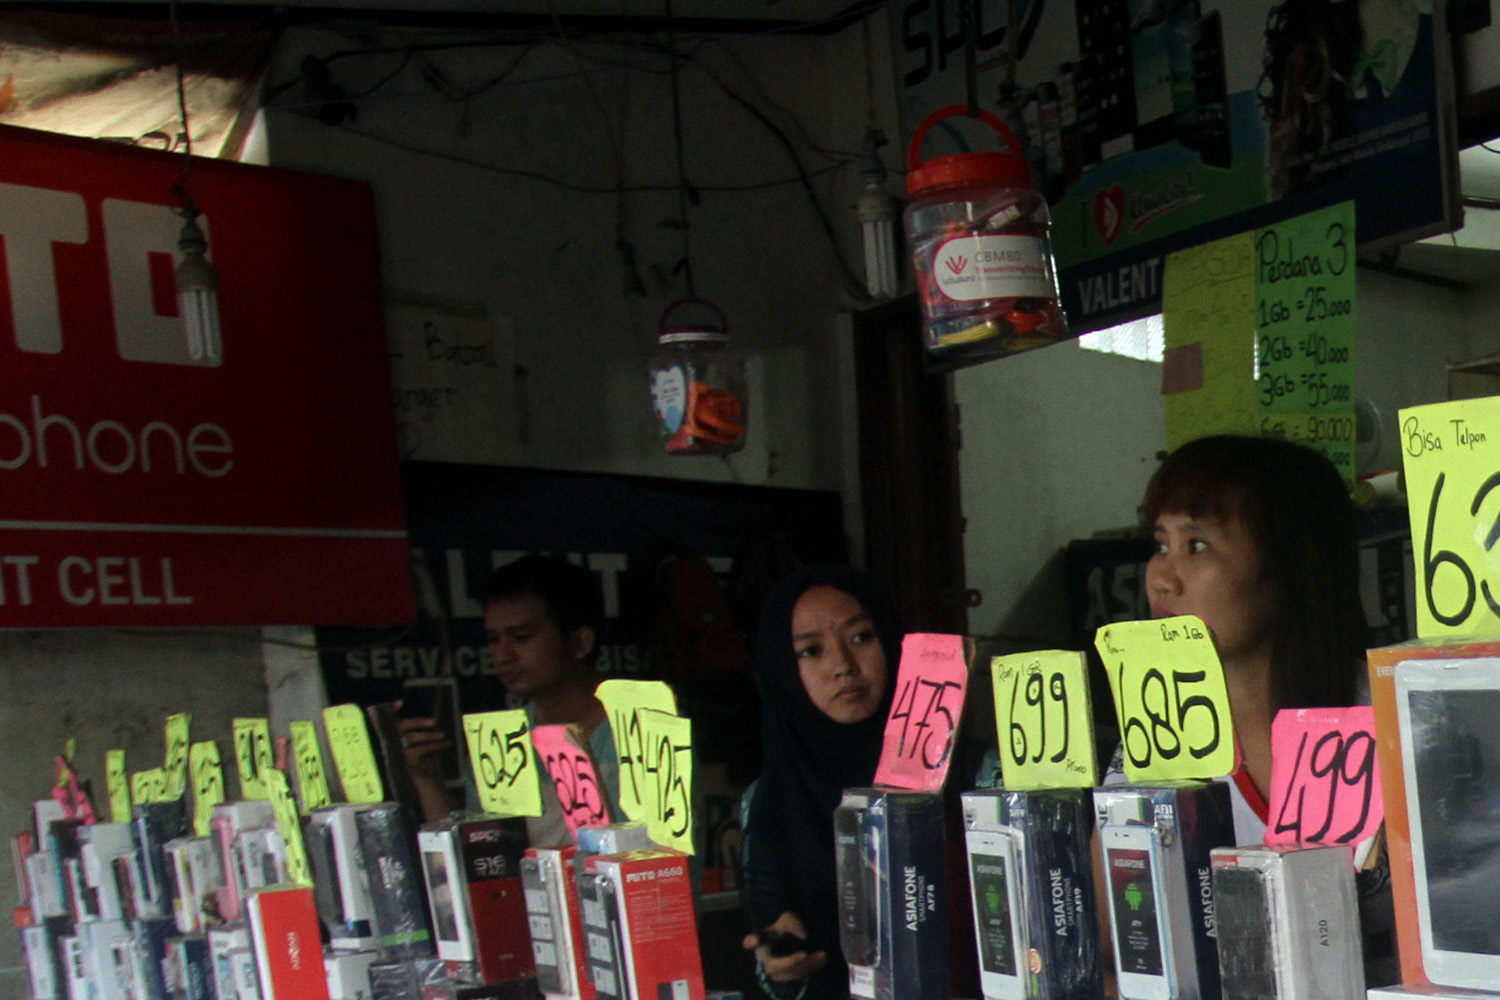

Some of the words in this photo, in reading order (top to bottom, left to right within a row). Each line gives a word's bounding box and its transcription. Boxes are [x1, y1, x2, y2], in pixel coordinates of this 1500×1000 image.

[1078, 257, 1162, 314] VALENT
[1258, 231, 1322, 284] Perdana
[1326, 222, 1348, 276] 3
[1404, 417, 1443, 458] Bisa
[1449, 419, 1487, 448] Telpon
[58, 557, 193, 604] CELL
[892, 676, 961, 770] 475
[1010, 672, 1068, 766] 699
[1120, 662, 1219, 768] 685
[1274, 730, 1376, 843] 499
[904, 865, 918, 931] ASIAFONE
[1050, 868, 1068, 936] ASIAFONE
[1198, 867, 1217, 939] ASIAFONE
[1318, 919, 1330, 947] A120
